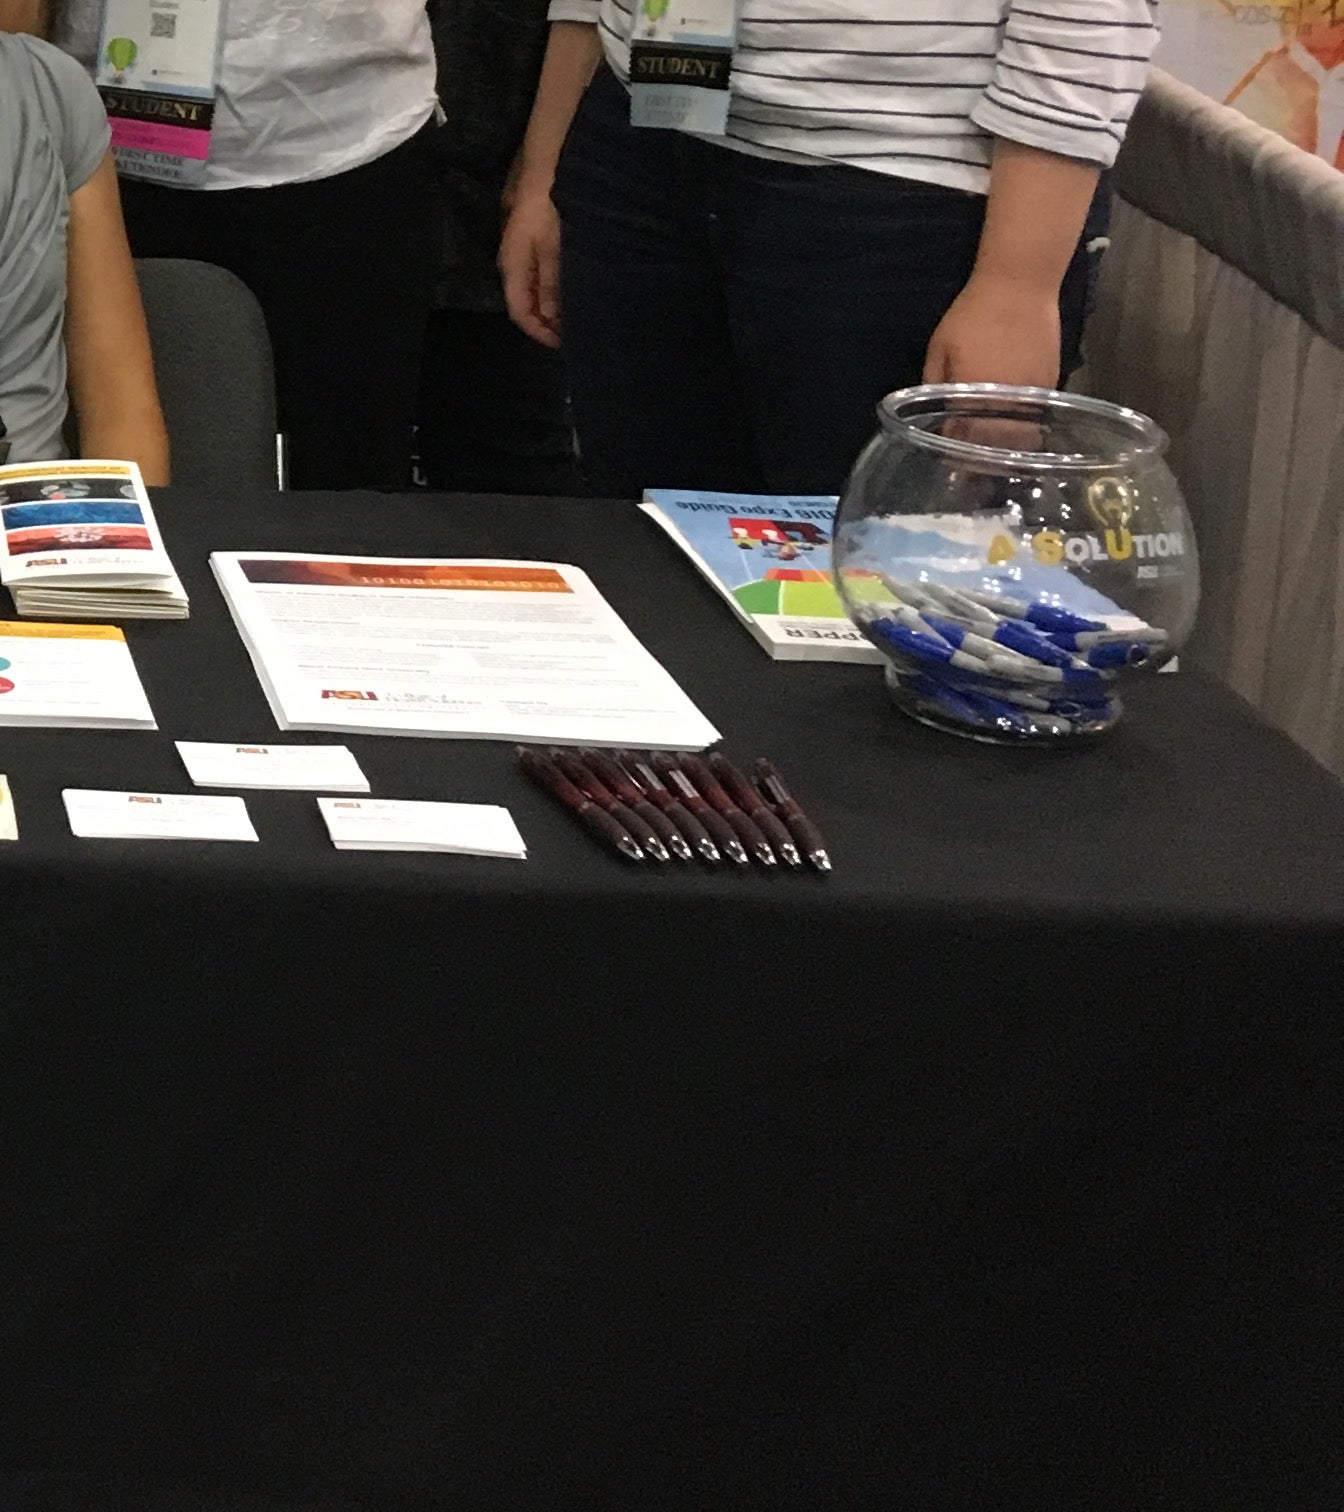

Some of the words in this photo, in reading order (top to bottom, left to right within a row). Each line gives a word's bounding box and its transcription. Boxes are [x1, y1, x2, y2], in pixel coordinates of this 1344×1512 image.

[637, 55, 721, 80] STUDENT
[676, 501, 737, 516] Guide
[742, 504, 793, 519] Expo
[321, 689, 378, 702] ASU
